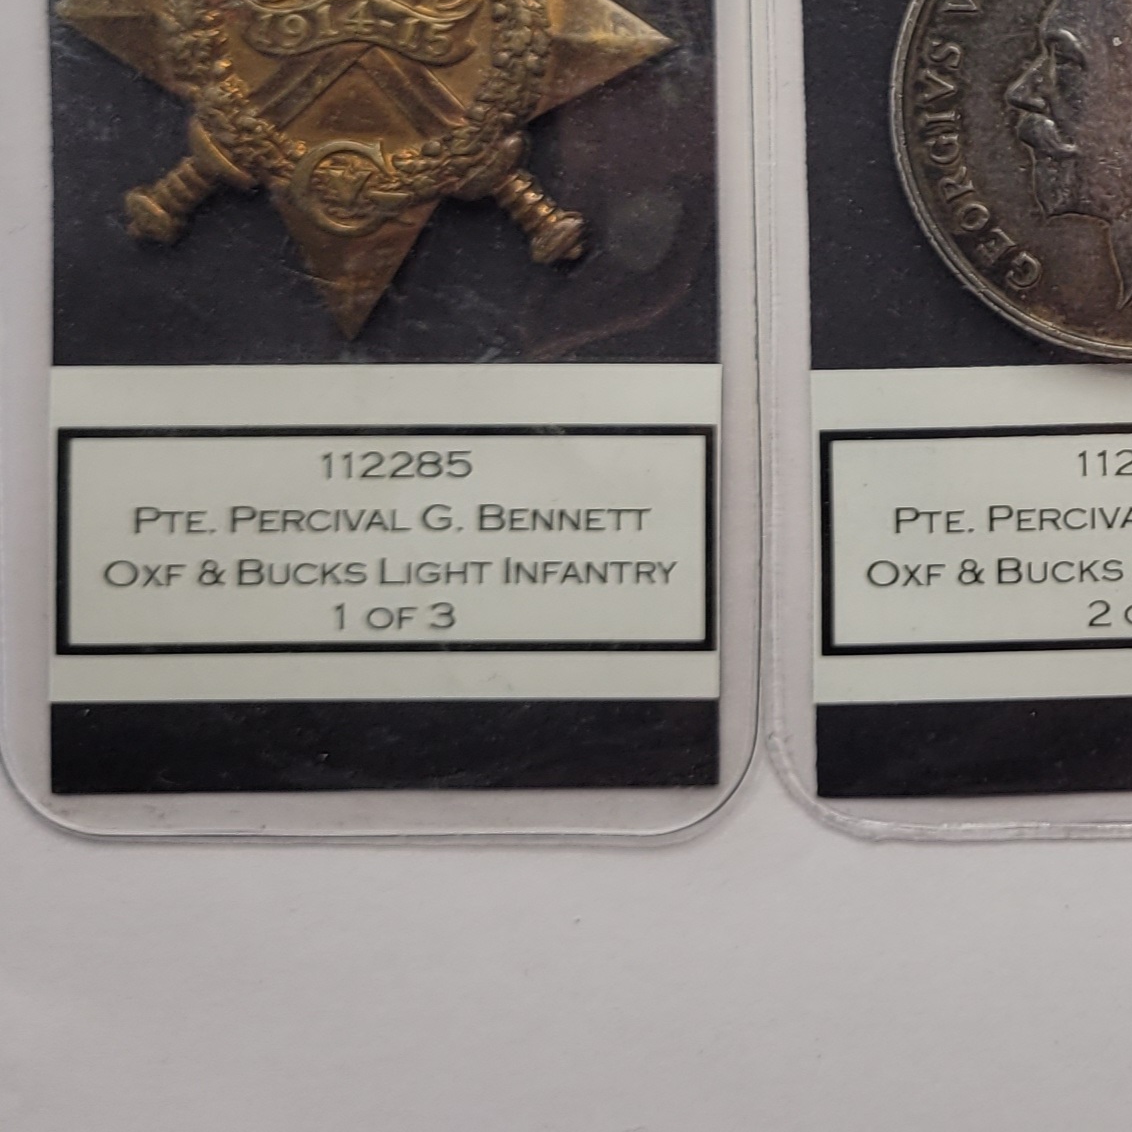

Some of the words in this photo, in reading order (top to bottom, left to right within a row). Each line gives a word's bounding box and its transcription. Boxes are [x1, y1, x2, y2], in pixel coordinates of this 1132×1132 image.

[254, 1, 456, 56] 1914-15
[922, 39, 1042, 291] GEORGIVS
[321, 450, 473, 480] 112285
[132, 505, 216, 535] PTE.
[228, 505, 410, 534] PERCIVAL
[419, 503, 464, 533] G.
[476, 503, 652, 533] BENNETT
[893, 506, 975, 535] PTE.
[102, 559, 186, 589] OXF
[195, 558, 226, 588] &
[235, 558, 368, 588] BUCKS
[378, 557, 493, 587] LIGHT
[502, 556, 677, 585] INFANTRY
[864, 559, 946, 589] OXF
[956, 558, 986, 587] &
[995, 556, 1125, 586] BUCKS
[334, 602, 345, 631] 1
[365, 606, 418, 631] OF
[428, 601, 457, 631] 3
[1087, 599, 1112, 629] 2
